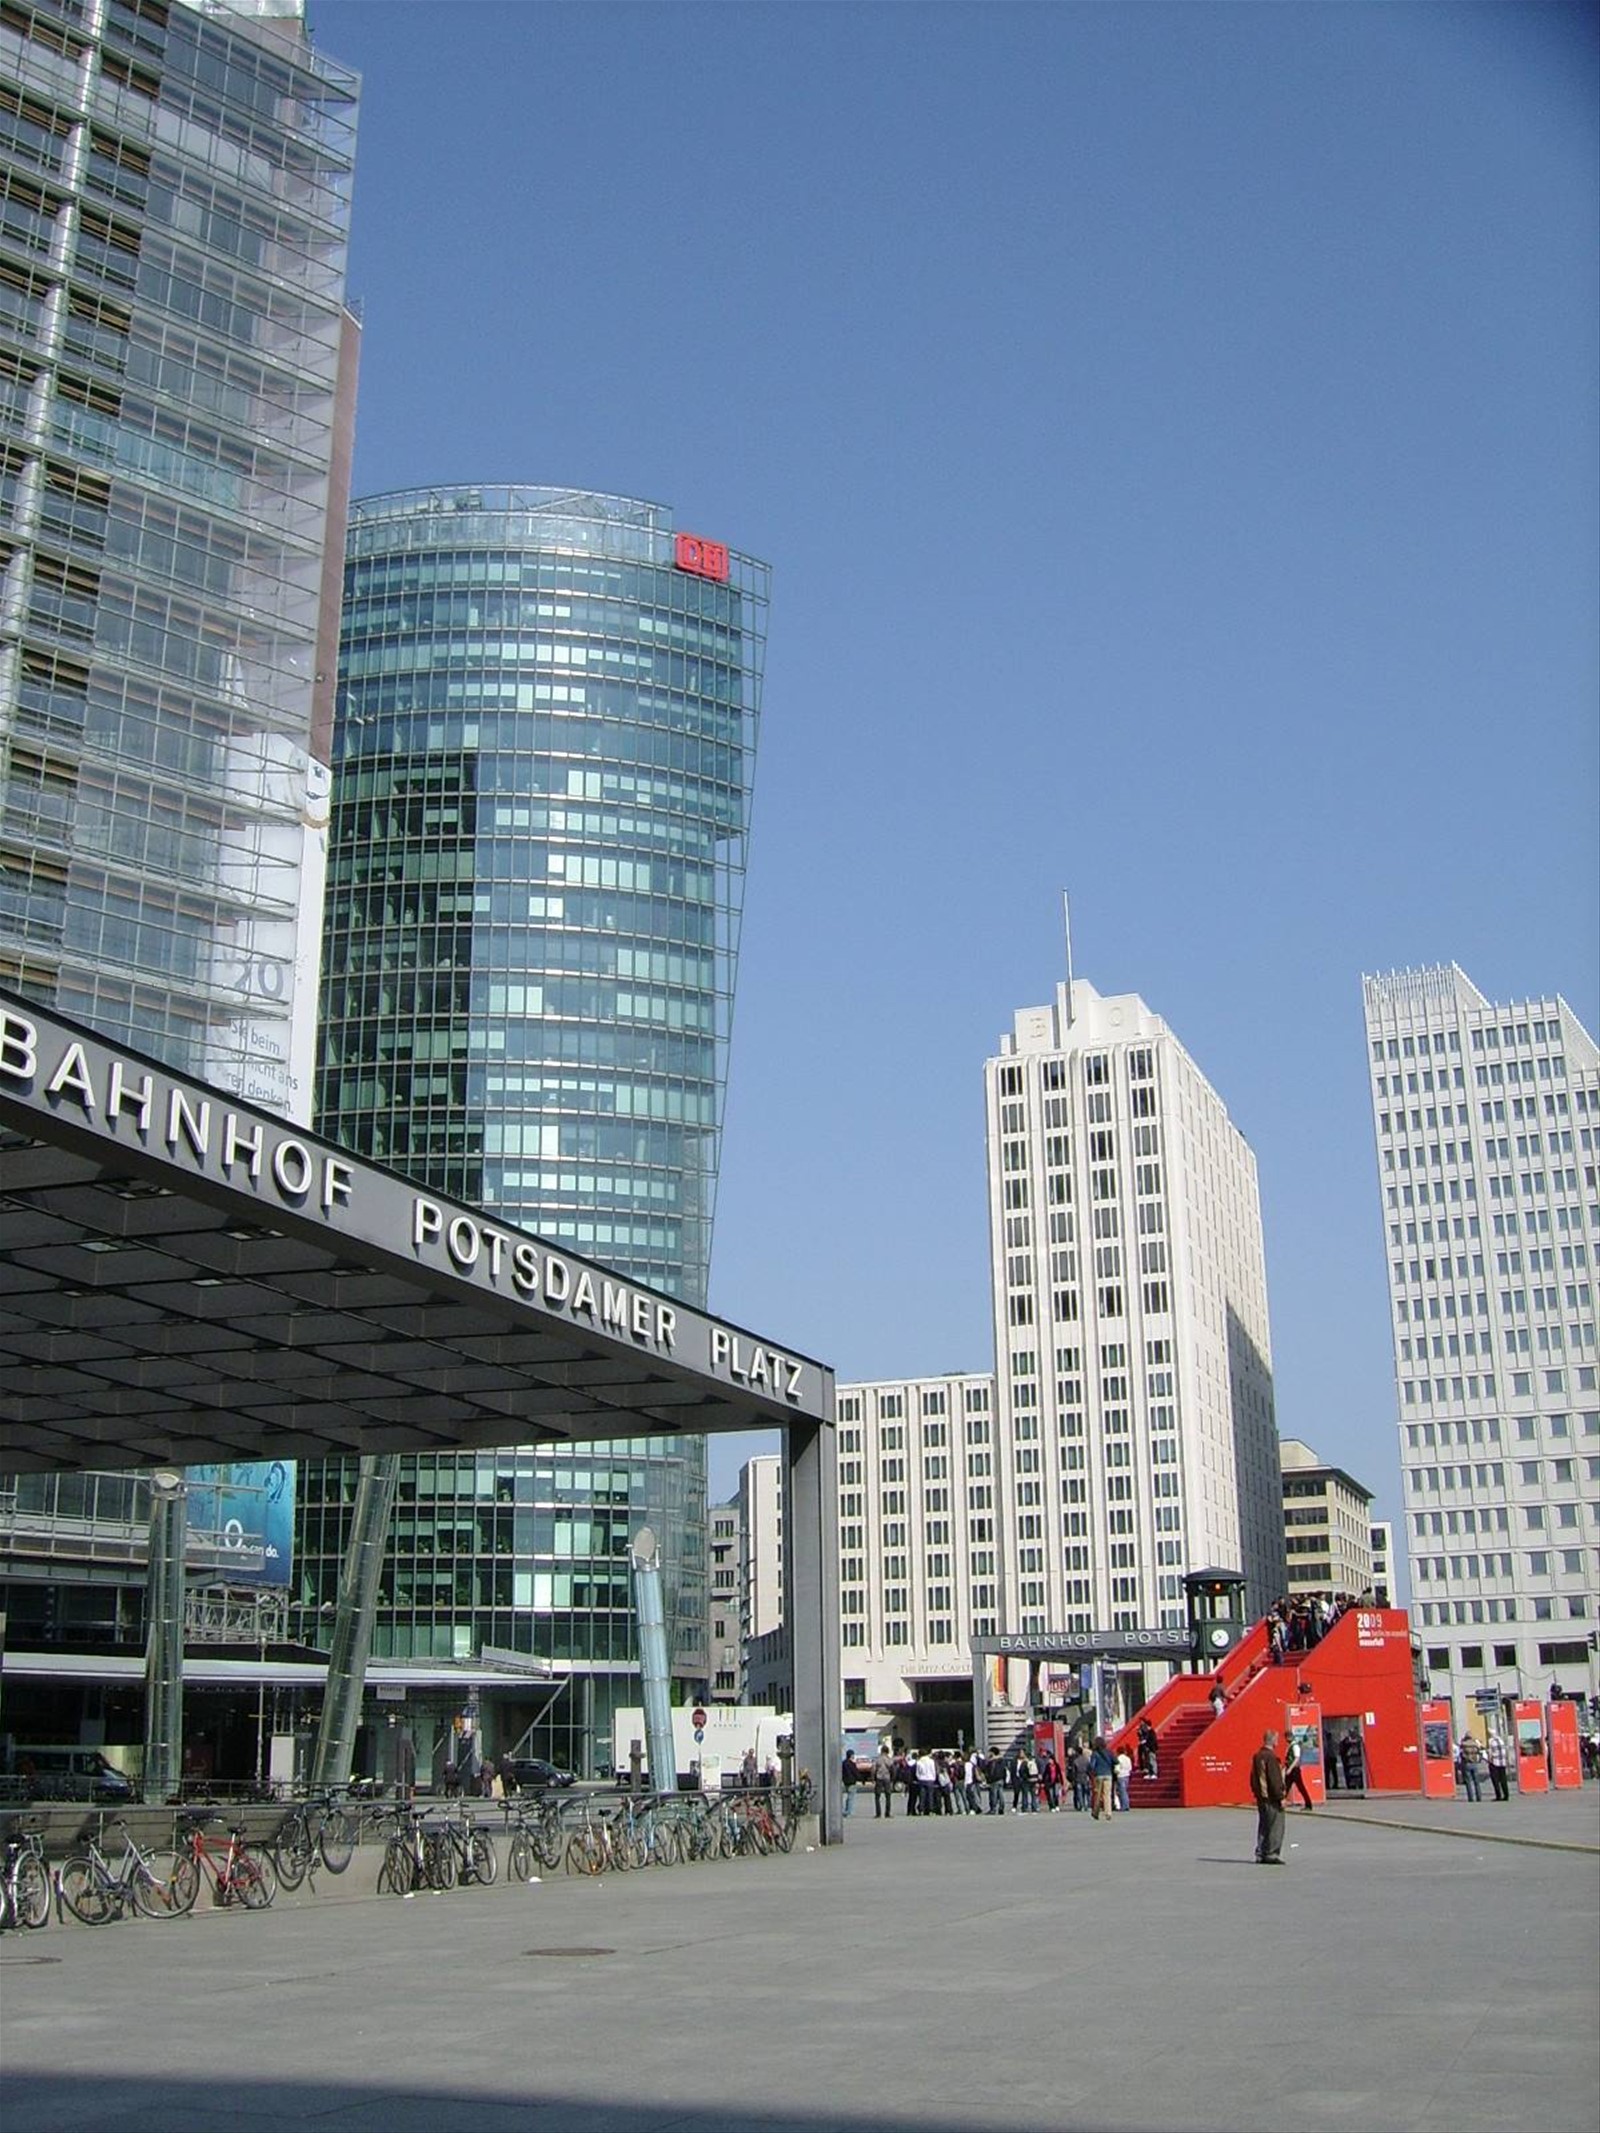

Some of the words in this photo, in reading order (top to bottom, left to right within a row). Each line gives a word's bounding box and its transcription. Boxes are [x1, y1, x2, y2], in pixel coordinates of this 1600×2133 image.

[251, 1026, 281, 1056] beim
[278, 1069, 299, 1091] ans
[0, 1007, 354, 1207] BAHNHOF
[413, 1197, 677, 1347] POTSDAMER
[711, 1328, 803, 1398] PLATZ
[1357, 1613, 1383, 1628] 2009
[1000, 1633, 1102, 1649] BAHNHOF
[1051, 1679, 1069, 1692] DB
